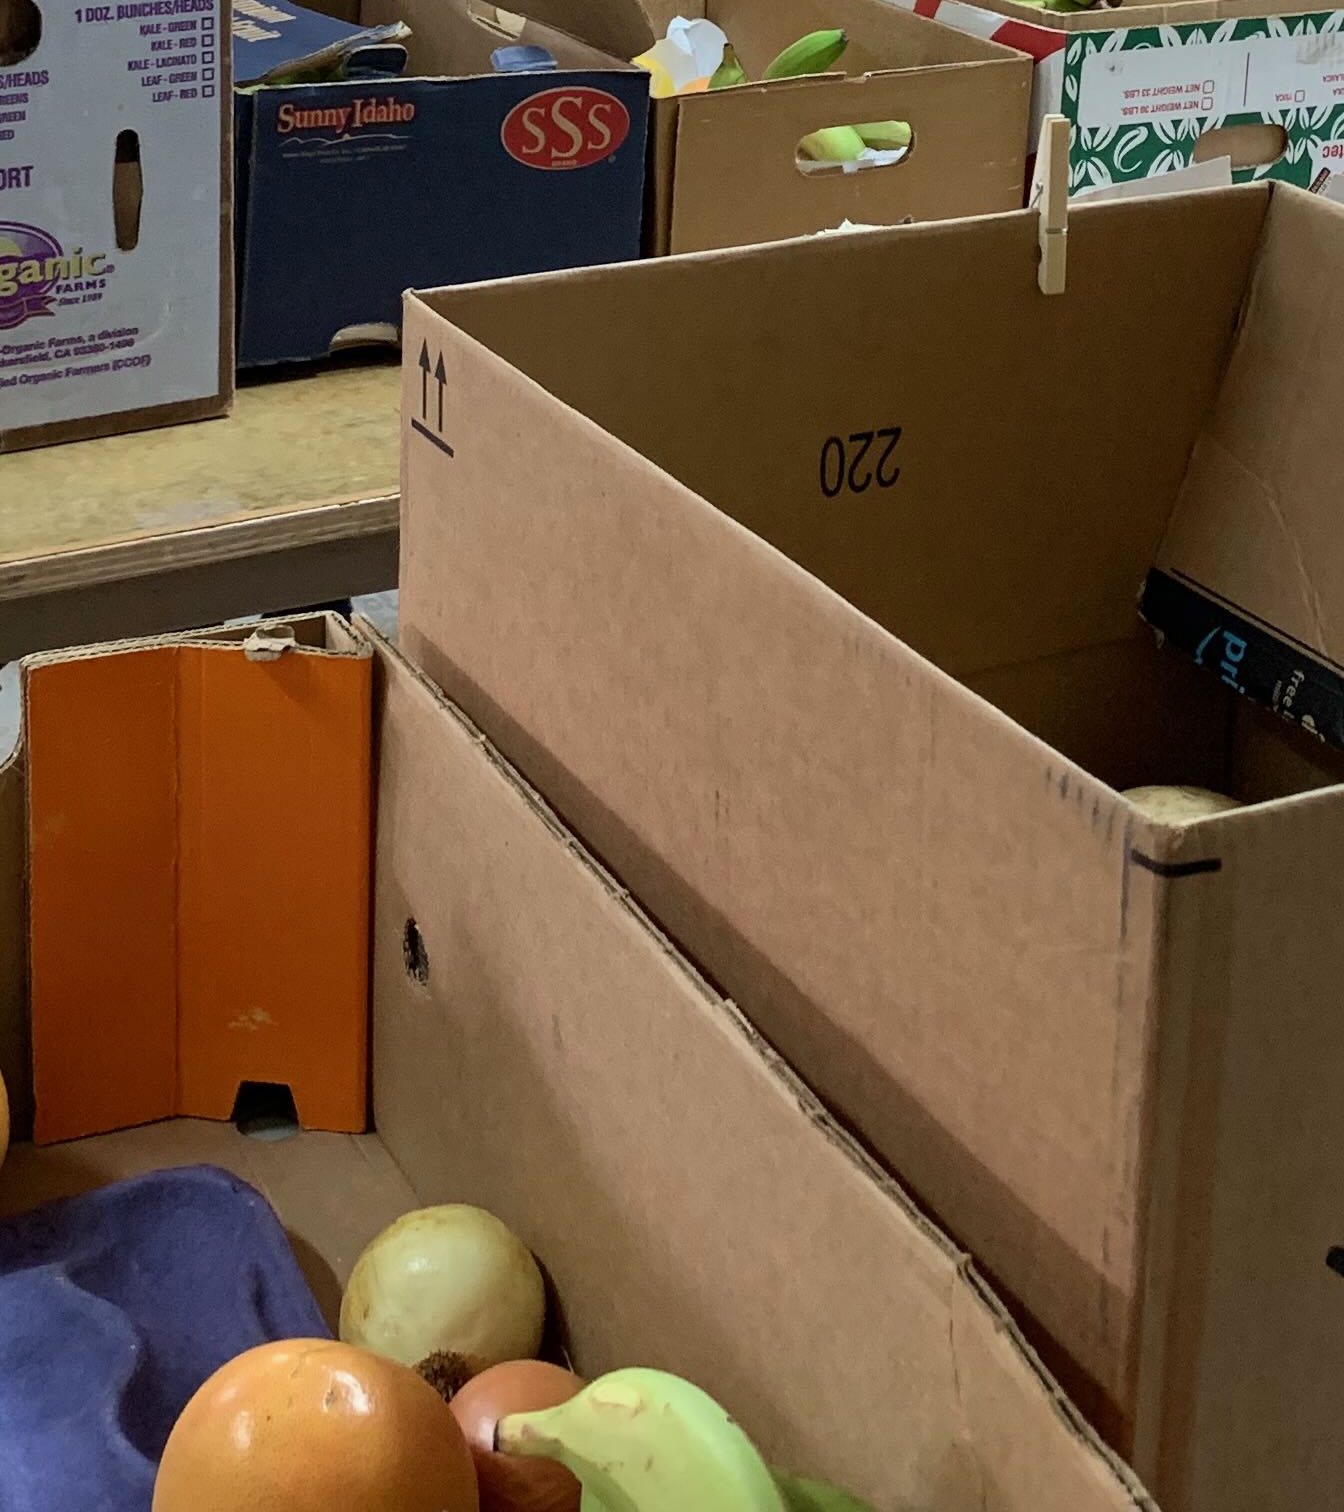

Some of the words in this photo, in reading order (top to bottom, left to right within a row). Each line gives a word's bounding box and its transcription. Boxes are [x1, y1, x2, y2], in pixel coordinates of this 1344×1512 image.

[74, 8, 82, 24] 1
[85, 6, 115, 23] DOZ.
[139, 23, 162, 37] KALE
[167, 20, 198, 33] GREEN
[151, 39, 174, 52] KALE
[179, 37, 198, 49] RED
[127, 58, 150, 72] KALE
[141, 74, 163, 87] LEAF
[168, 71, 198, 85] GREEN
[151, 90, 174, 103] LEAF
[179, 87, 198, 100] RED
[1122, 88, 1142, 99] LBS.
[1152, 84, 1184, 96] WEIGHT
[1184, 83, 1201, 94] NET
[1120, 104, 1139, 116] LBS.
[1150, 101, 1183, 113] WEIGHT
[1183, 99, 1200, 111] NET
[276, 103, 351, 135] Sunny
[351, 96, 415, 129] Idaho
[520, 95, 612, 159] SSS
[55, 278, 107, 295] FARMS
[54, 347, 71, 359] CA
[18, 369, 64, 386] Organic
[64, 361, 110, 378] Farmers
[819, 425, 904, 499] 220
[1282, 669, 1307, 709] free
